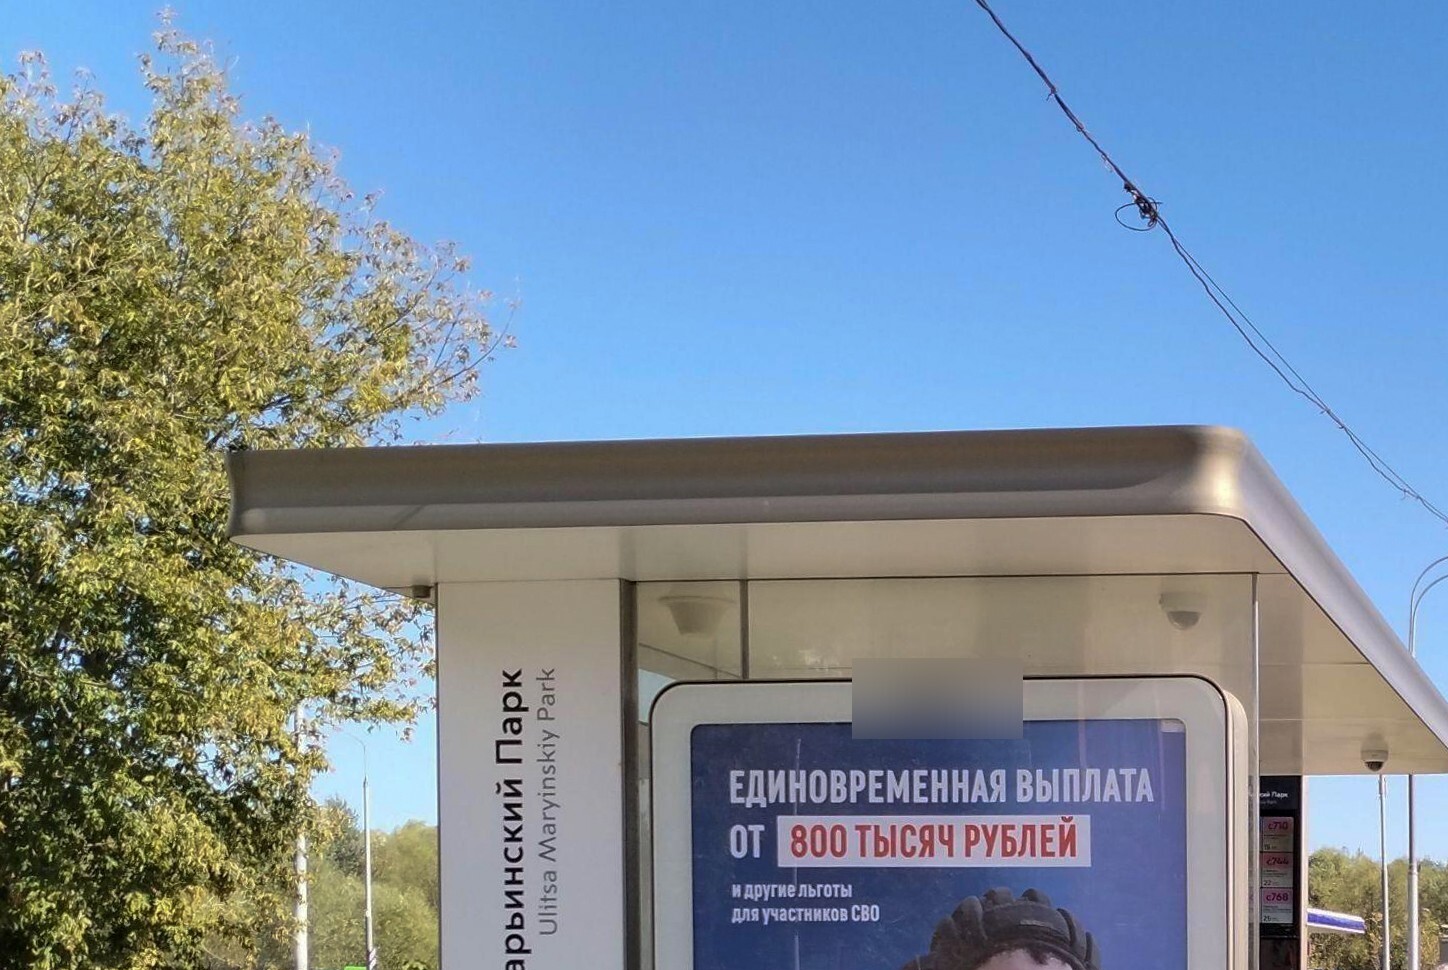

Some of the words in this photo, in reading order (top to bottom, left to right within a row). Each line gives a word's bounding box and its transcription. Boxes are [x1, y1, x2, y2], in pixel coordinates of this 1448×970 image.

[495, 669, 529, 764] Парк
[535, 667, 558, 722] Park
[536, 729, 561, 863] Maryinskiy
[729, 768, 1007, 808] ЕДИНОВРЕМЕННАЯ
[1016, 767, 1155, 803] ВЫПЛАТА
[729, 824, 765, 859] ОТ
[790, 824, 848, 859] 800
[854, 824, 955, 858] ТЫСЯЧ
[964, 815, 1077, 858] РУБЛЕЙ
[537, 871, 558, 936] Ulitsa
[731, 883, 741, 898] и
[743, 883, 797, 902] другие
[798, 883, 853, 898] льготы
[731, 907, 760, 924] для
[761, 907, 849, 926] участников
[851, 904, 881, 922] СВО
